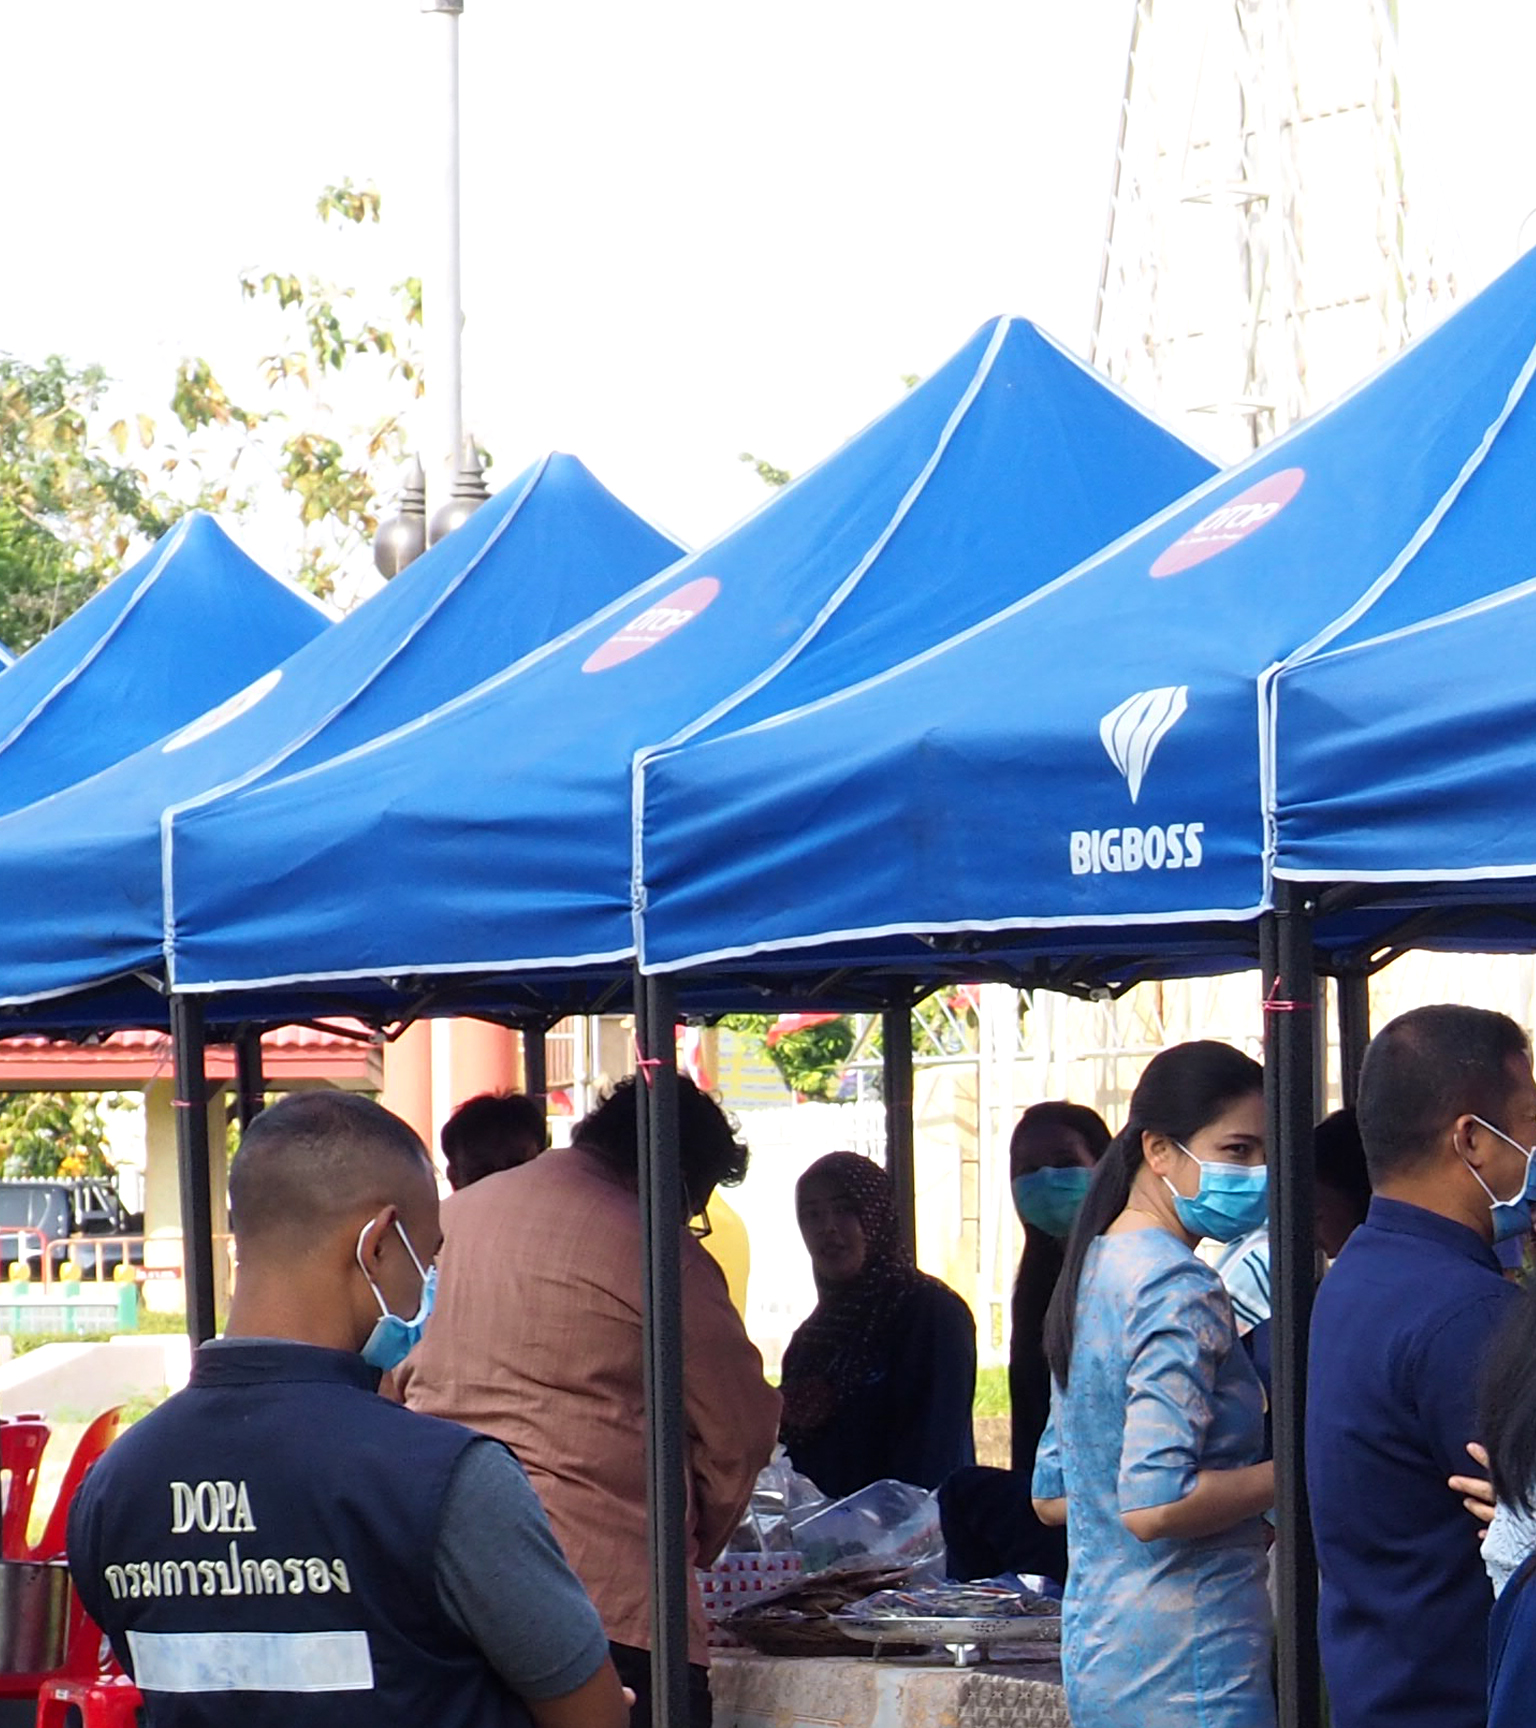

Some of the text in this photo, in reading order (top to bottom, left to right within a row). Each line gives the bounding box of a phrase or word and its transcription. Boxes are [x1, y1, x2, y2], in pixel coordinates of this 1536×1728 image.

[1069, 822, 1205, 875] BIGBOSS
[169, 1480, 257, 1534] DOPA
[104, 1540, 352, 1600] กรมการปกครอง
